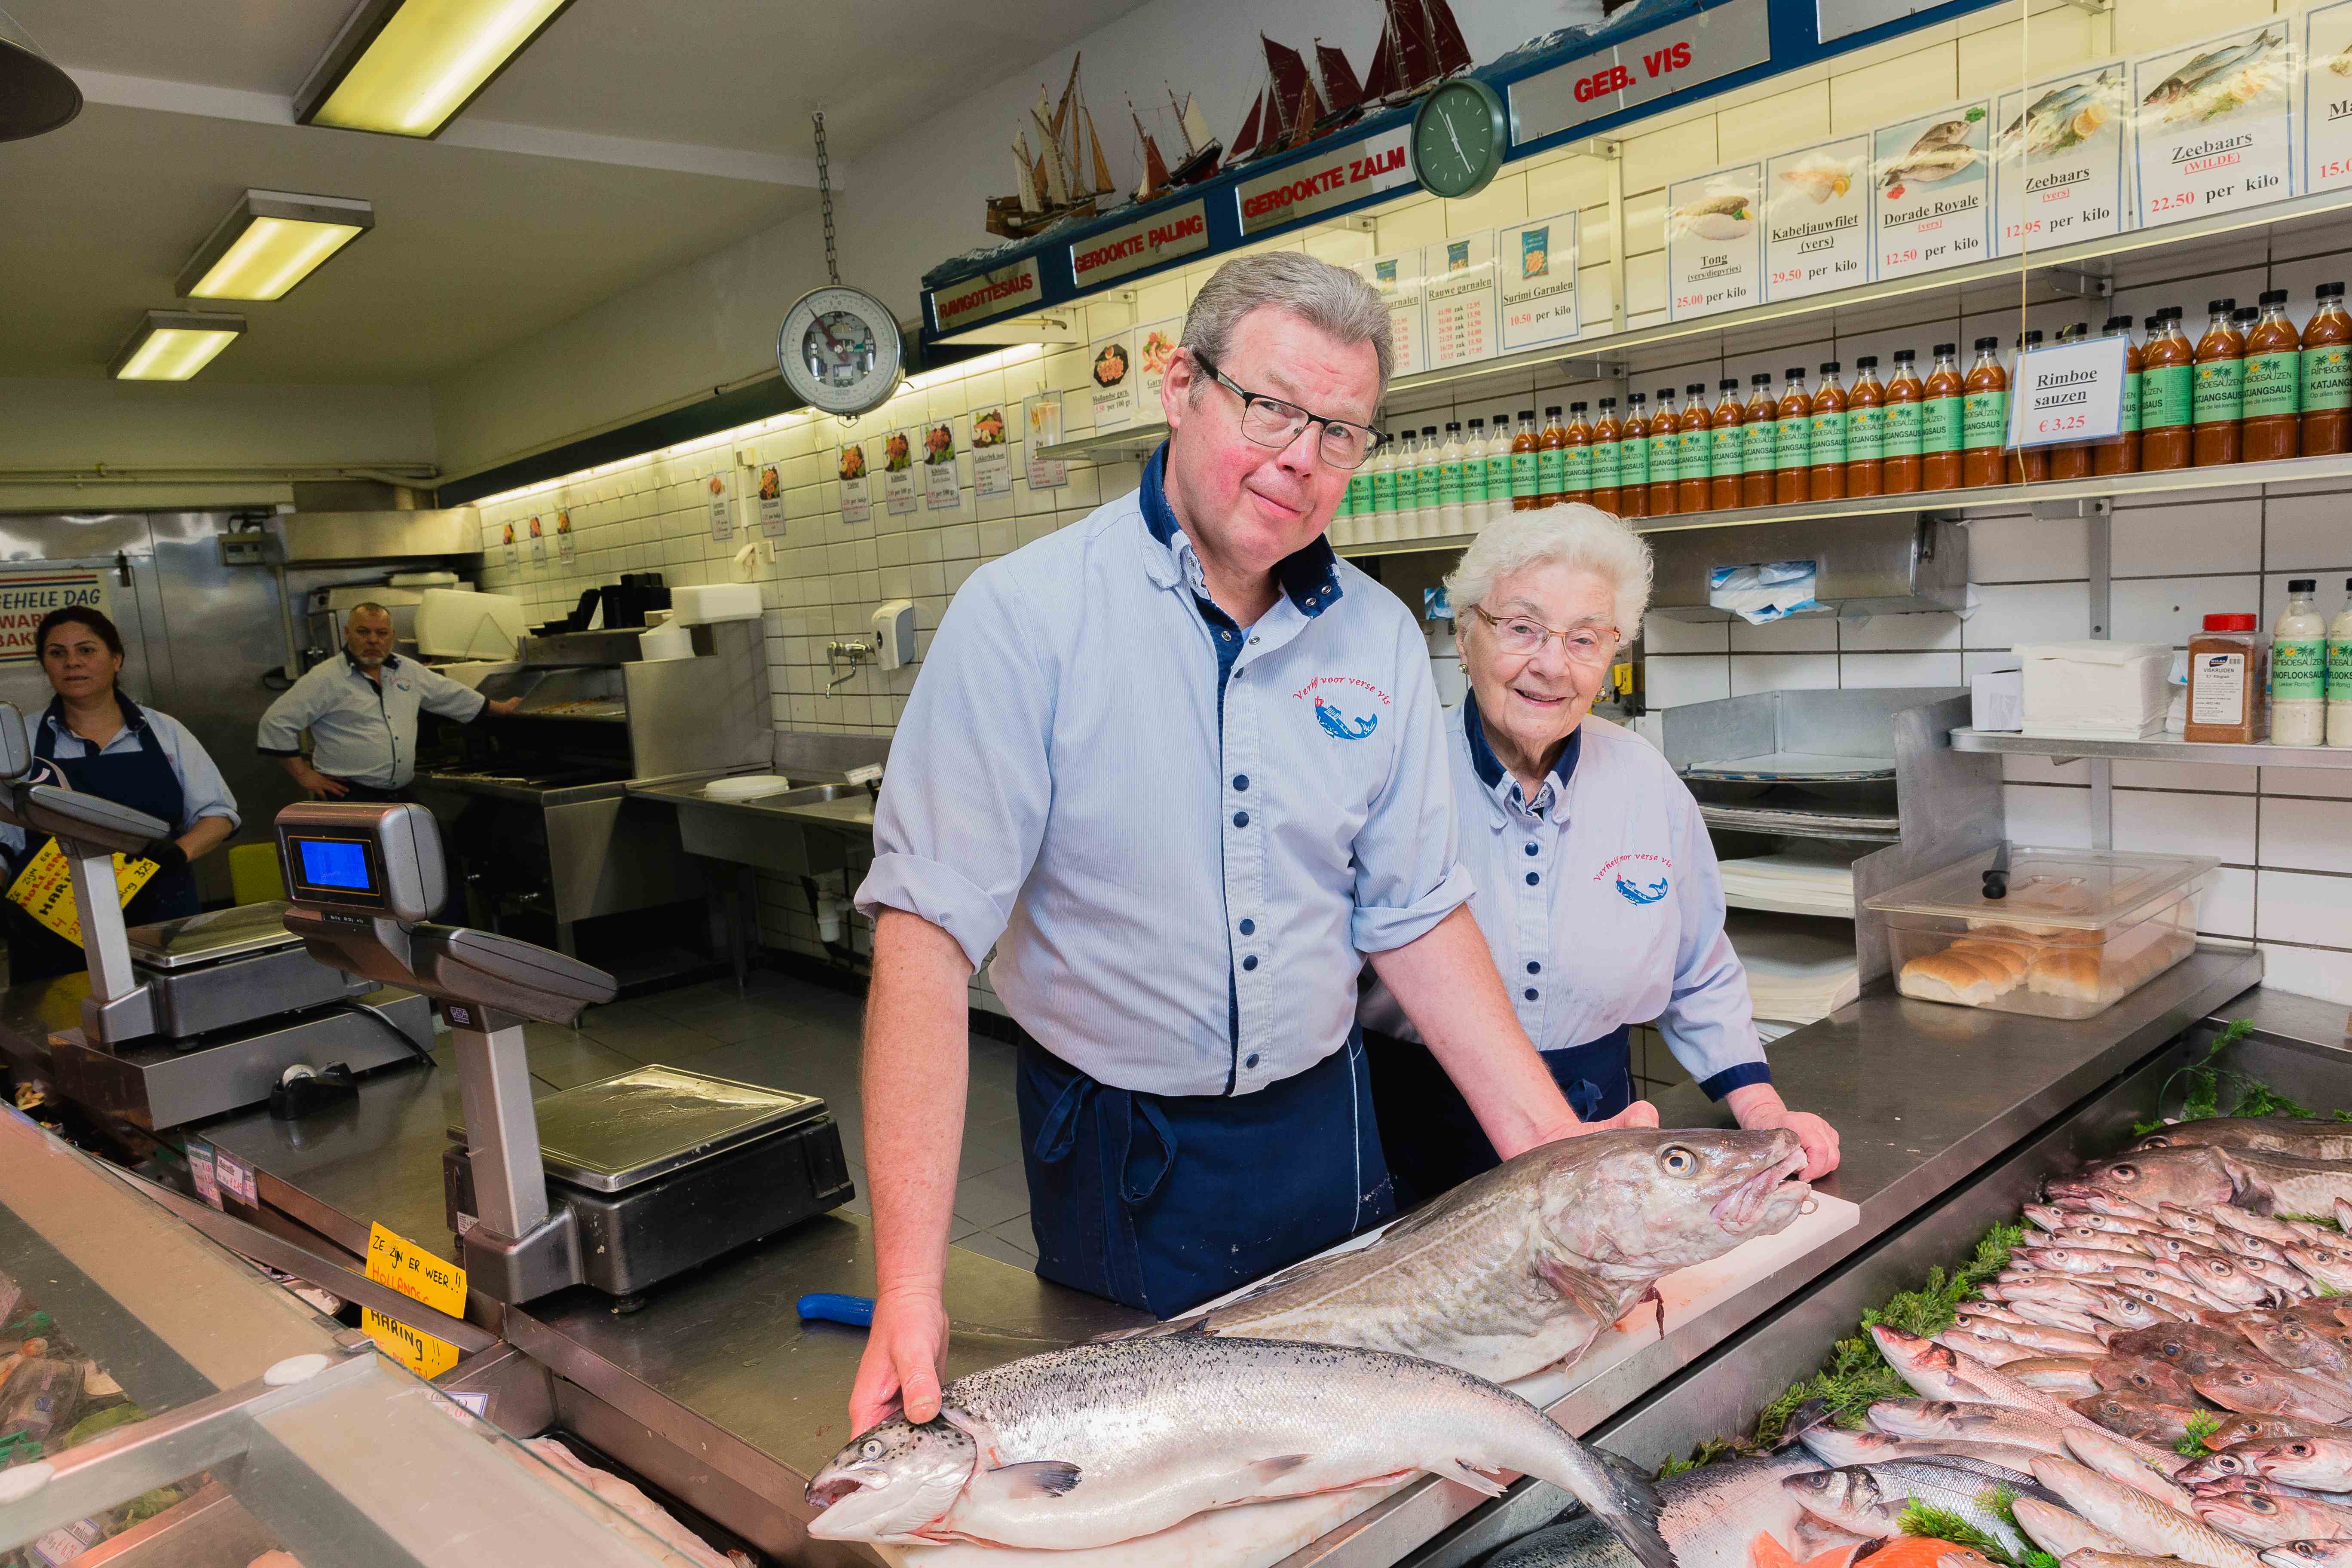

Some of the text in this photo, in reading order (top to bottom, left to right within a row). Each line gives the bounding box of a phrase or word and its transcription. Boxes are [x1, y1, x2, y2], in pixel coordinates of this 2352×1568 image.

[1574, 42, 1691, 103] GEB. VIS
[2172, 133, 2253, 162] Zeebaars
[2184, 152, 2241, 175] (WILDE)
[1243, 146, 1406, 218] GEROOKTE ZALM
[2025, 168, 2090, 192] Zeebaars
[2042, 188, 2070, 202] (vers)
[2151, 174, 2279, 212] 22.50 per kilo
[1884, 195, 1979, 227] Dorade Royale
[2006, 206, 2110, 239] 12.95 per kilo
[1772, 214, 1859, 241] Kabeljauwfilet
[1918, 219, 1943, 233] (vers)
[1075, 214, 1204, 273] GEROOKTE PALING
[1801, 235, 1834, 254] (vers)
[1886, 237, 1979, 266] 12.50 per kilo
[1700, 254, 1728, 268] Tong
[1772, 259, 1858, 284] 29.50 per kilo
[1428, 279, 1492, 300] Rauwe garnalen
[1504, 281, 1574, 304] Surimi Garnalen
[1677, 287, 1747, 308] 25.00 per kilo
[1510, 305, 1571, 326] 10.50 per kilo
[2037, 369, 2098, 388] Rimboe
[2034, 391, 2087, 407] sauzen
[2039, 415, 2085, 432] € 3.25
[0, 588, 101, 609] EHELE DAG
[1348, 678, 1375, 692] verse
[1377, 690, 1390, 705] vis
[1661, 857, 1672, 868] vis
[373, 1235, 386, 1251] ZE
[409, 1257, 420, 1273] ER
